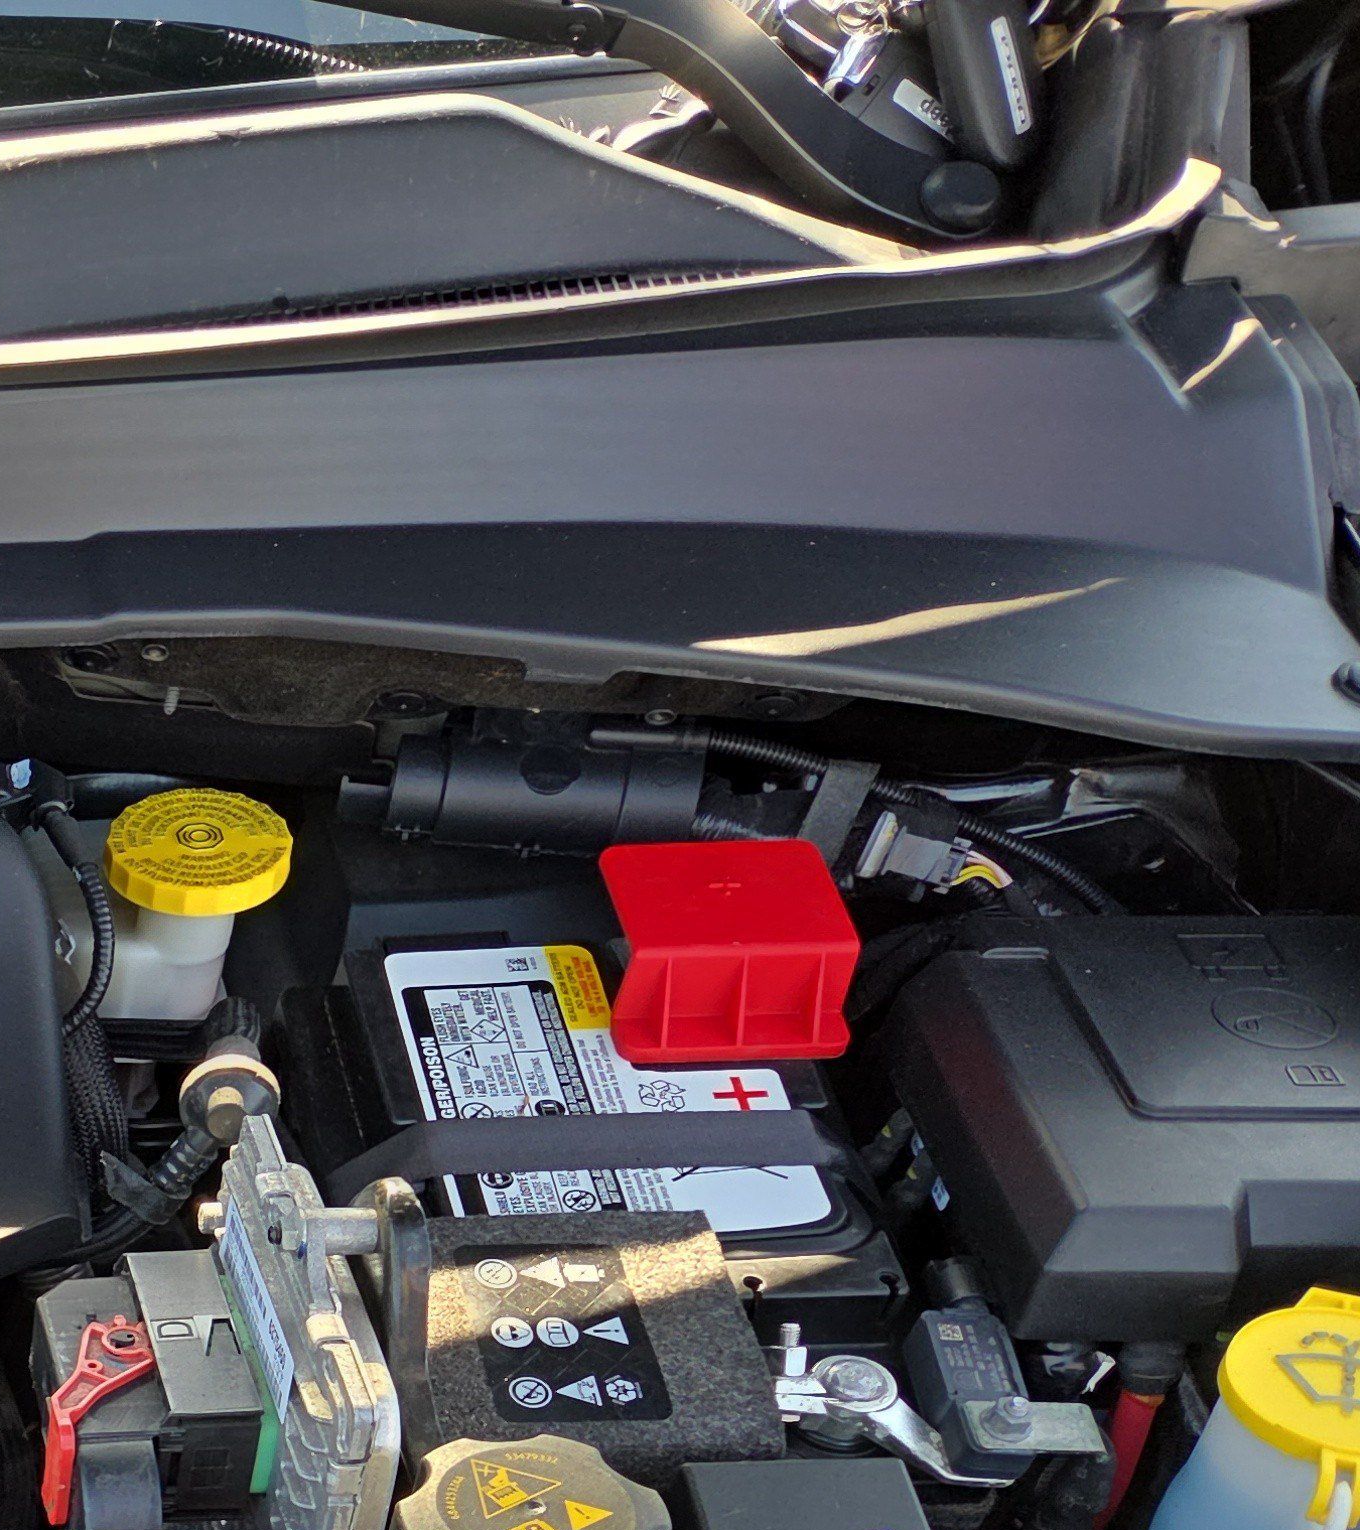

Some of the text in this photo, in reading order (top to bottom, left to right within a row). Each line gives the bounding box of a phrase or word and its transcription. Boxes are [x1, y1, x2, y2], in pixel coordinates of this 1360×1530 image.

[431, 1007, 449, 1042] FLUSH EYES
[420, 1036, 457, 1118] GER/POISON
[517, 1177, 537, 1213] EXPLOSIVE
